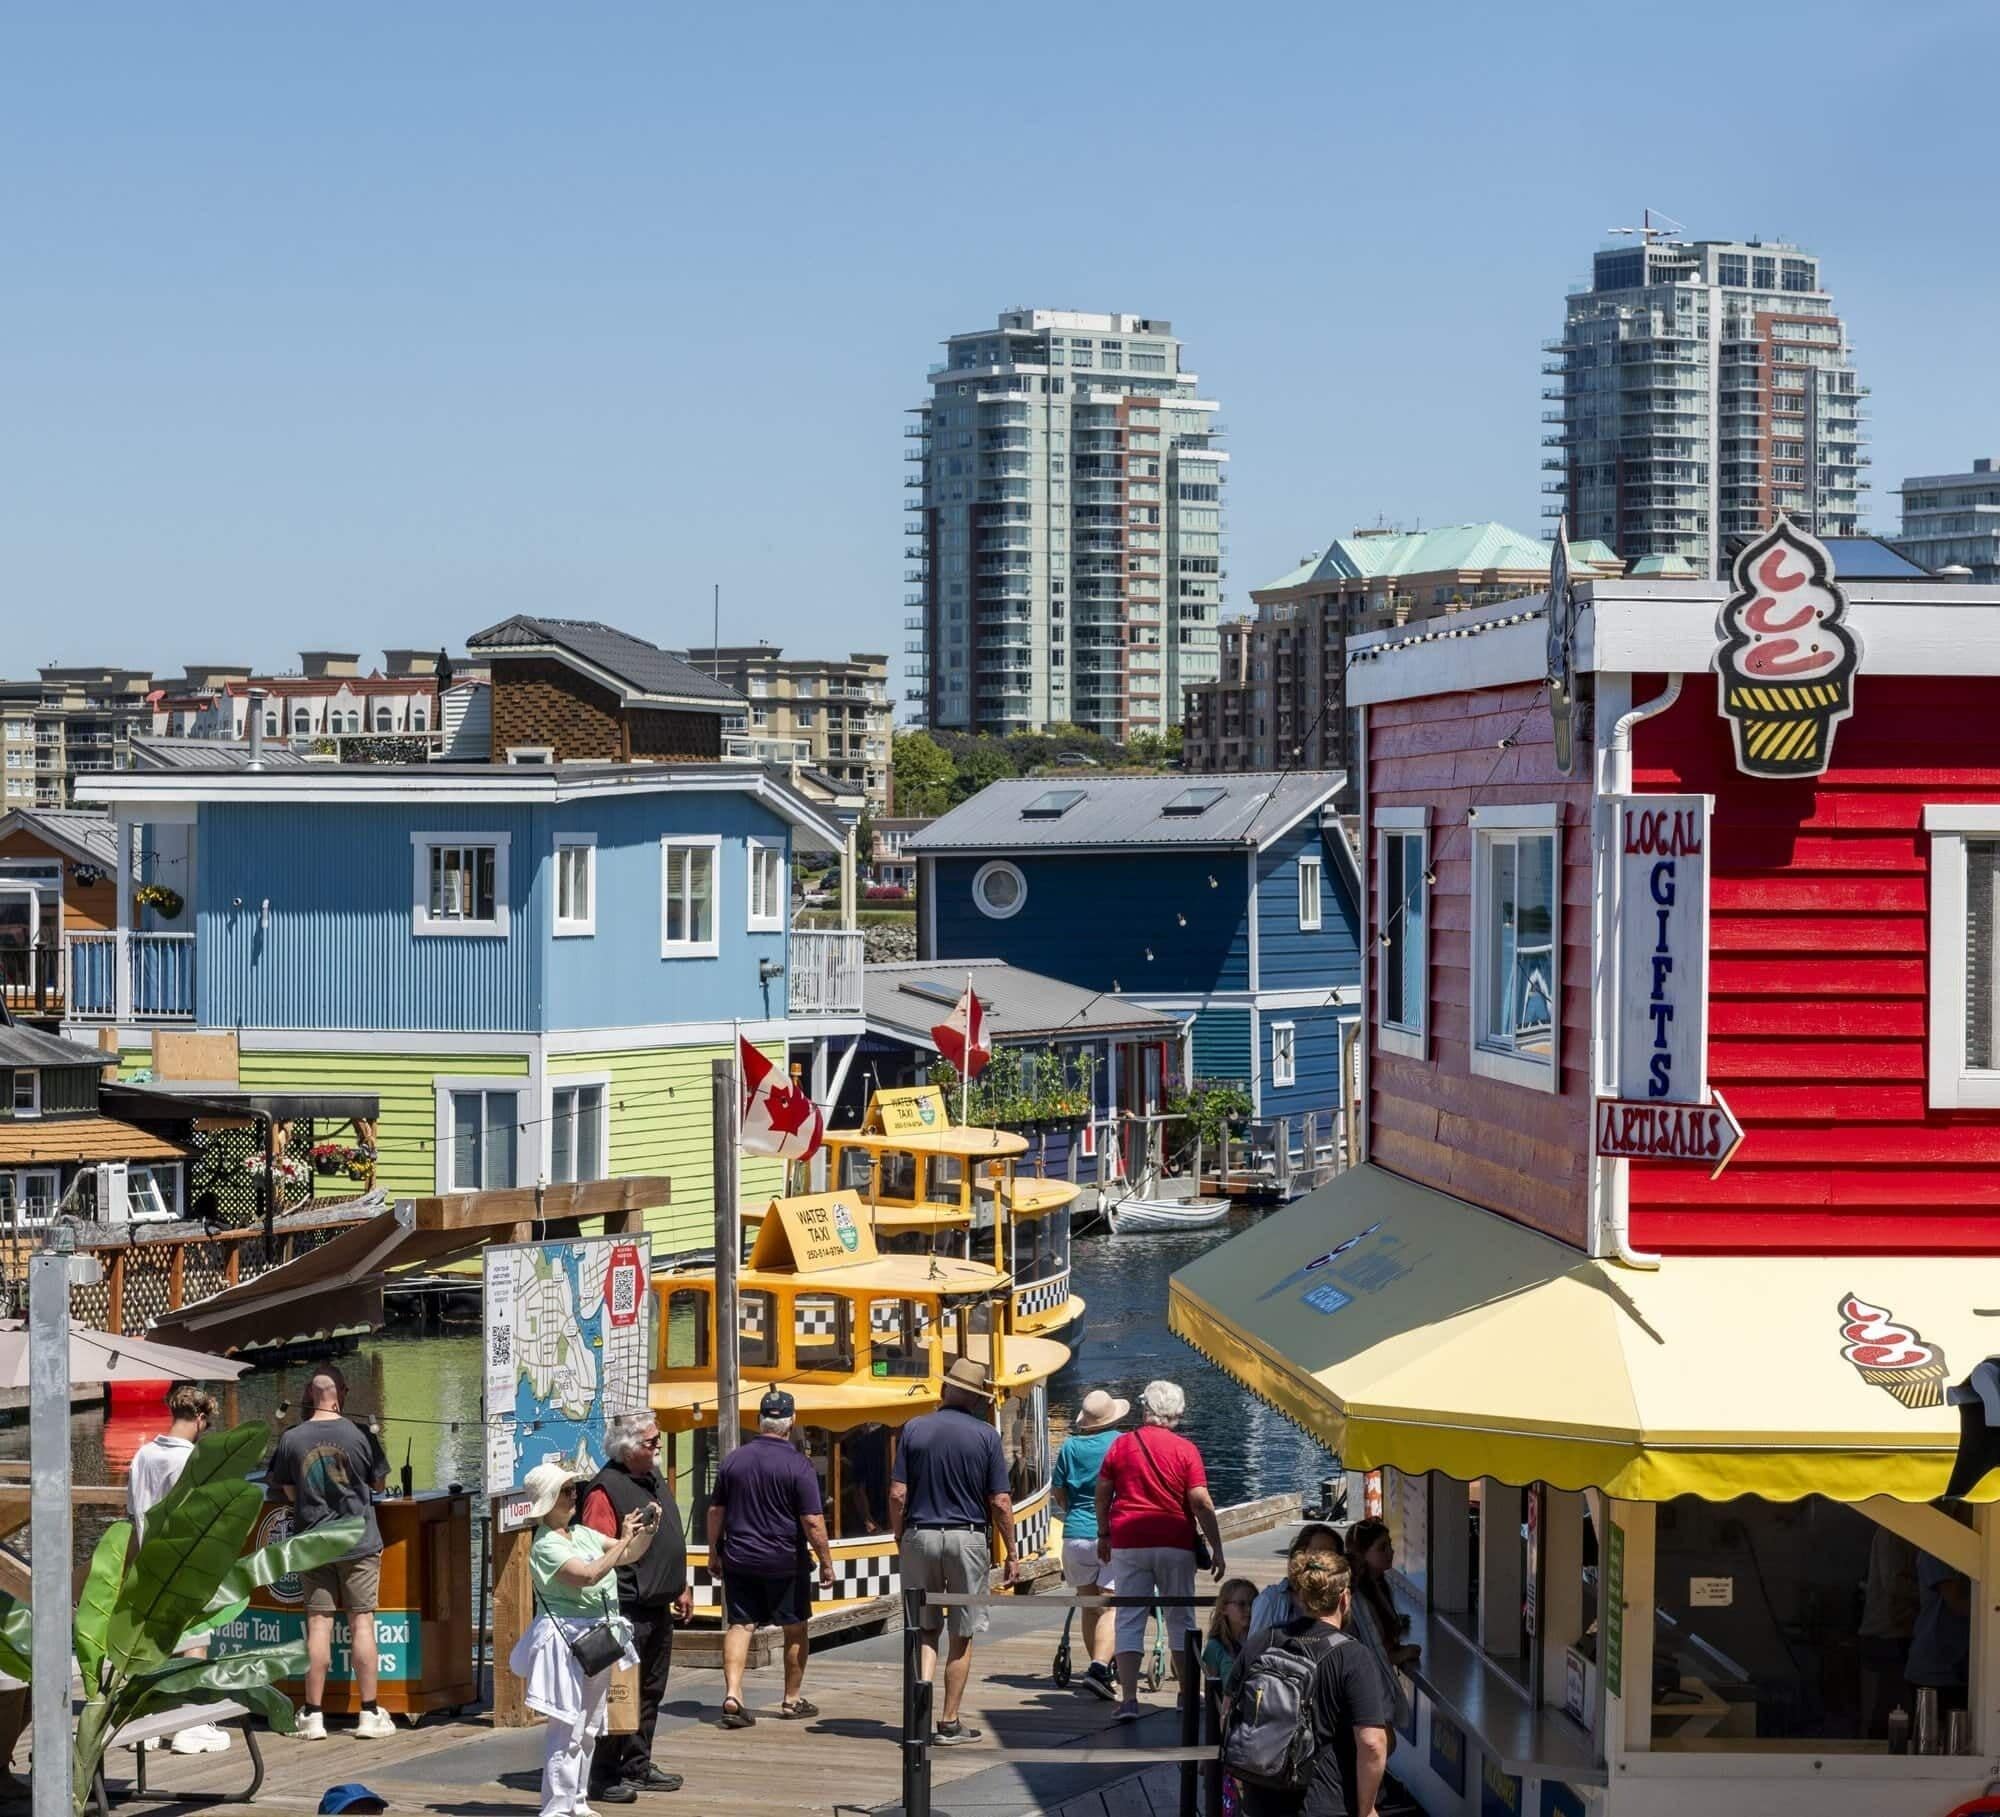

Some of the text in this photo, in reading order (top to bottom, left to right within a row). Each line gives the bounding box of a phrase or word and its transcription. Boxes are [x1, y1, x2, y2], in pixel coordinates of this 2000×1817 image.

[1624, 810, 1702, 857] LOCAL
[1649, 861, 1676, 1097] GIFTS
[897, 1109, 914, 1119] TAXI
[1601, 1105, 1721, 1157] ARTISANS
[796, 1208, 829, 1225] WATER
[807, 1226, 831, 1242] TAXI
[252, 1617, 280, 1642] Taxi
[373, 1620, 410, 1644] Taxi
[338, 1649, 397, 1673] Trs
